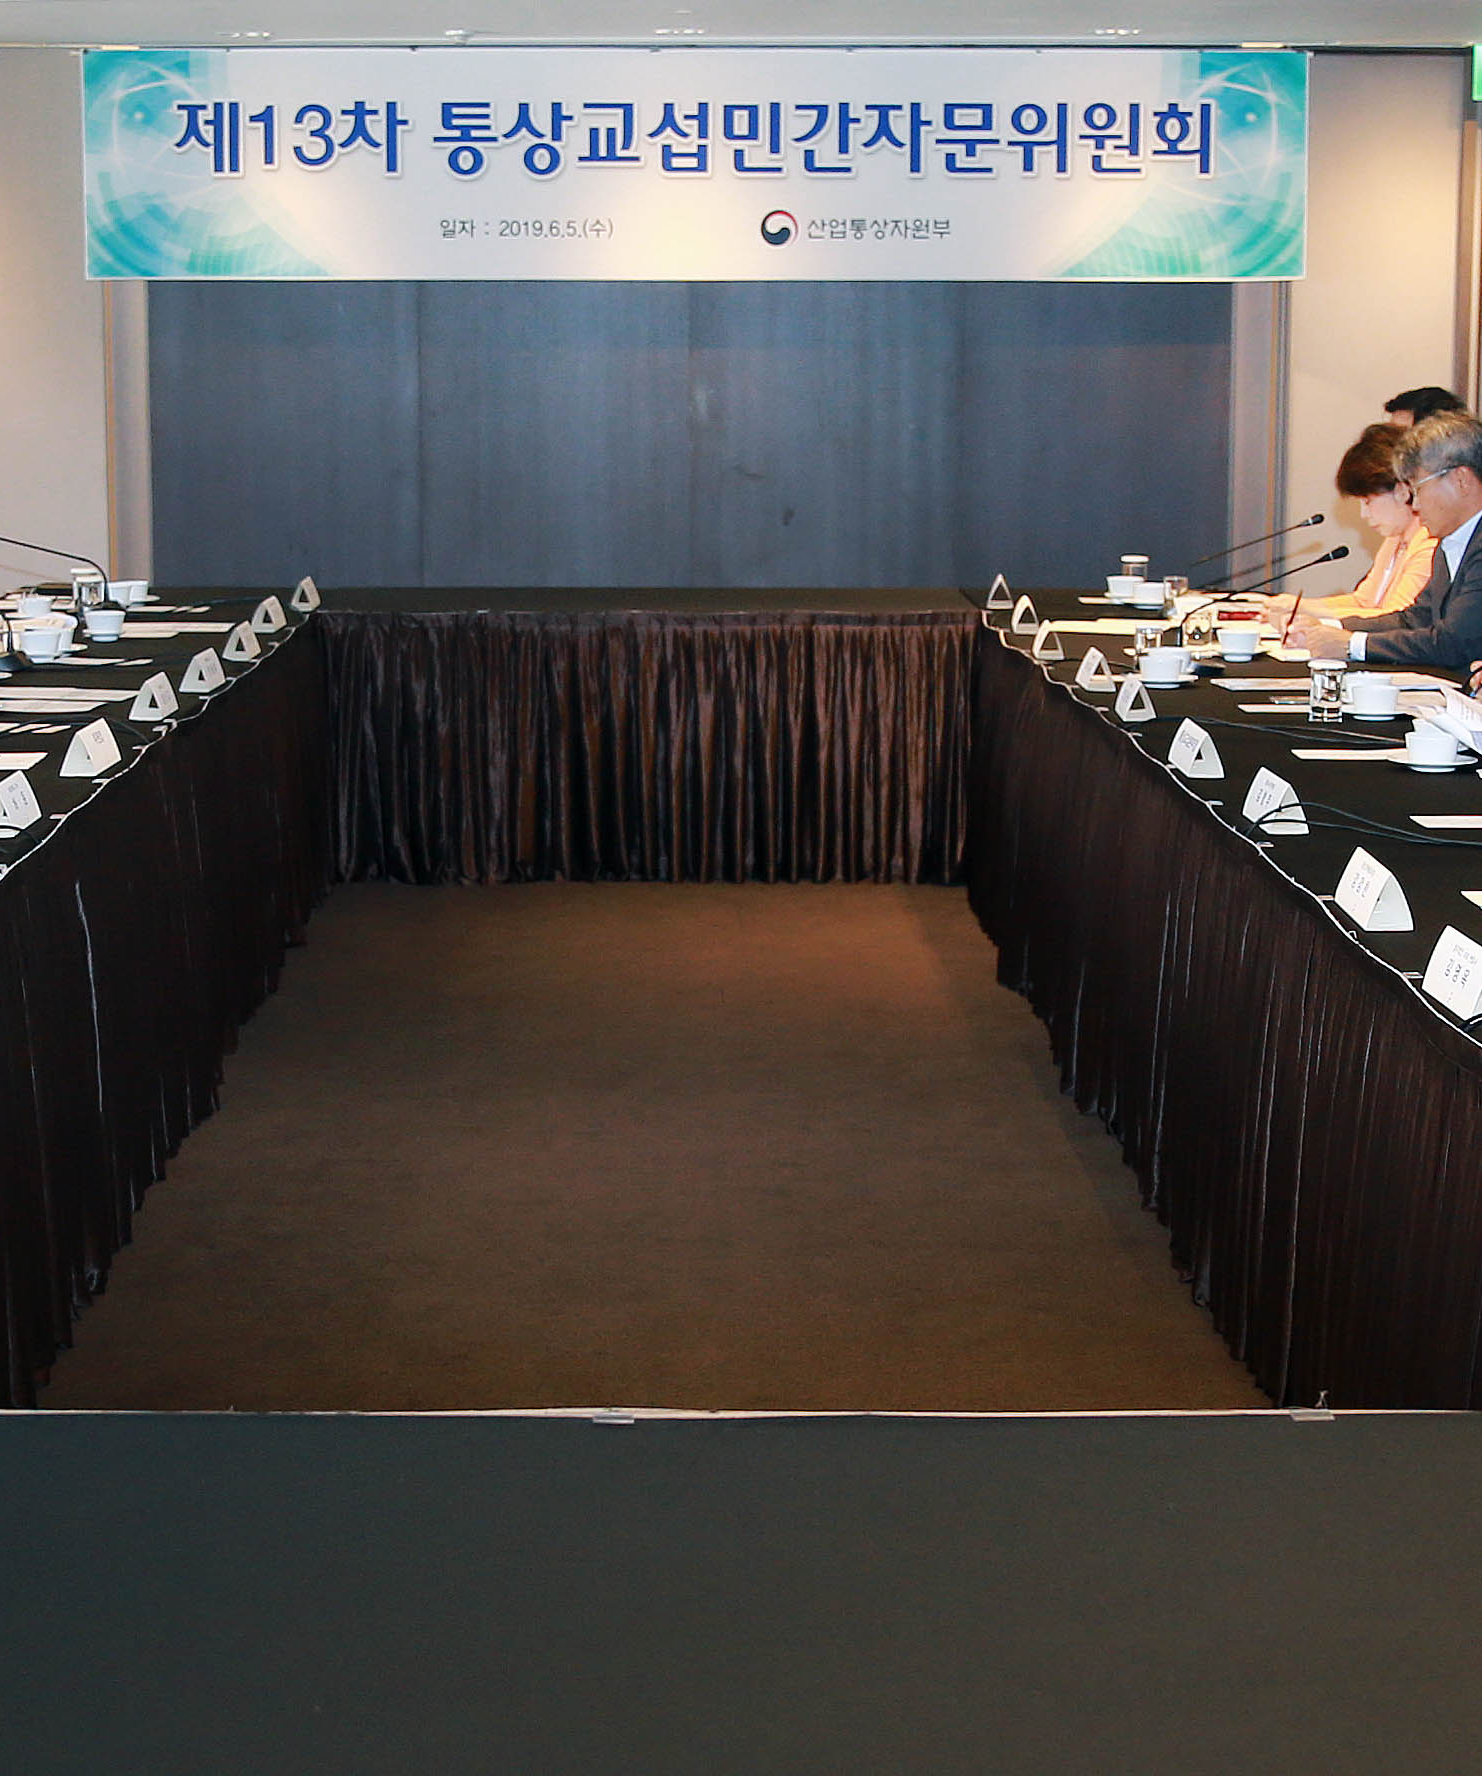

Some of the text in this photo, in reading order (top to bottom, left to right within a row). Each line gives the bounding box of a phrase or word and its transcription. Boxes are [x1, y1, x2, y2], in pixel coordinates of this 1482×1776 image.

[174, 99, 1217, 177] 제13차 통상교섭민간자문위원회
[439, 218, 477, 239] 일자
[807, 217, 952, 241] 산업통상자원부
